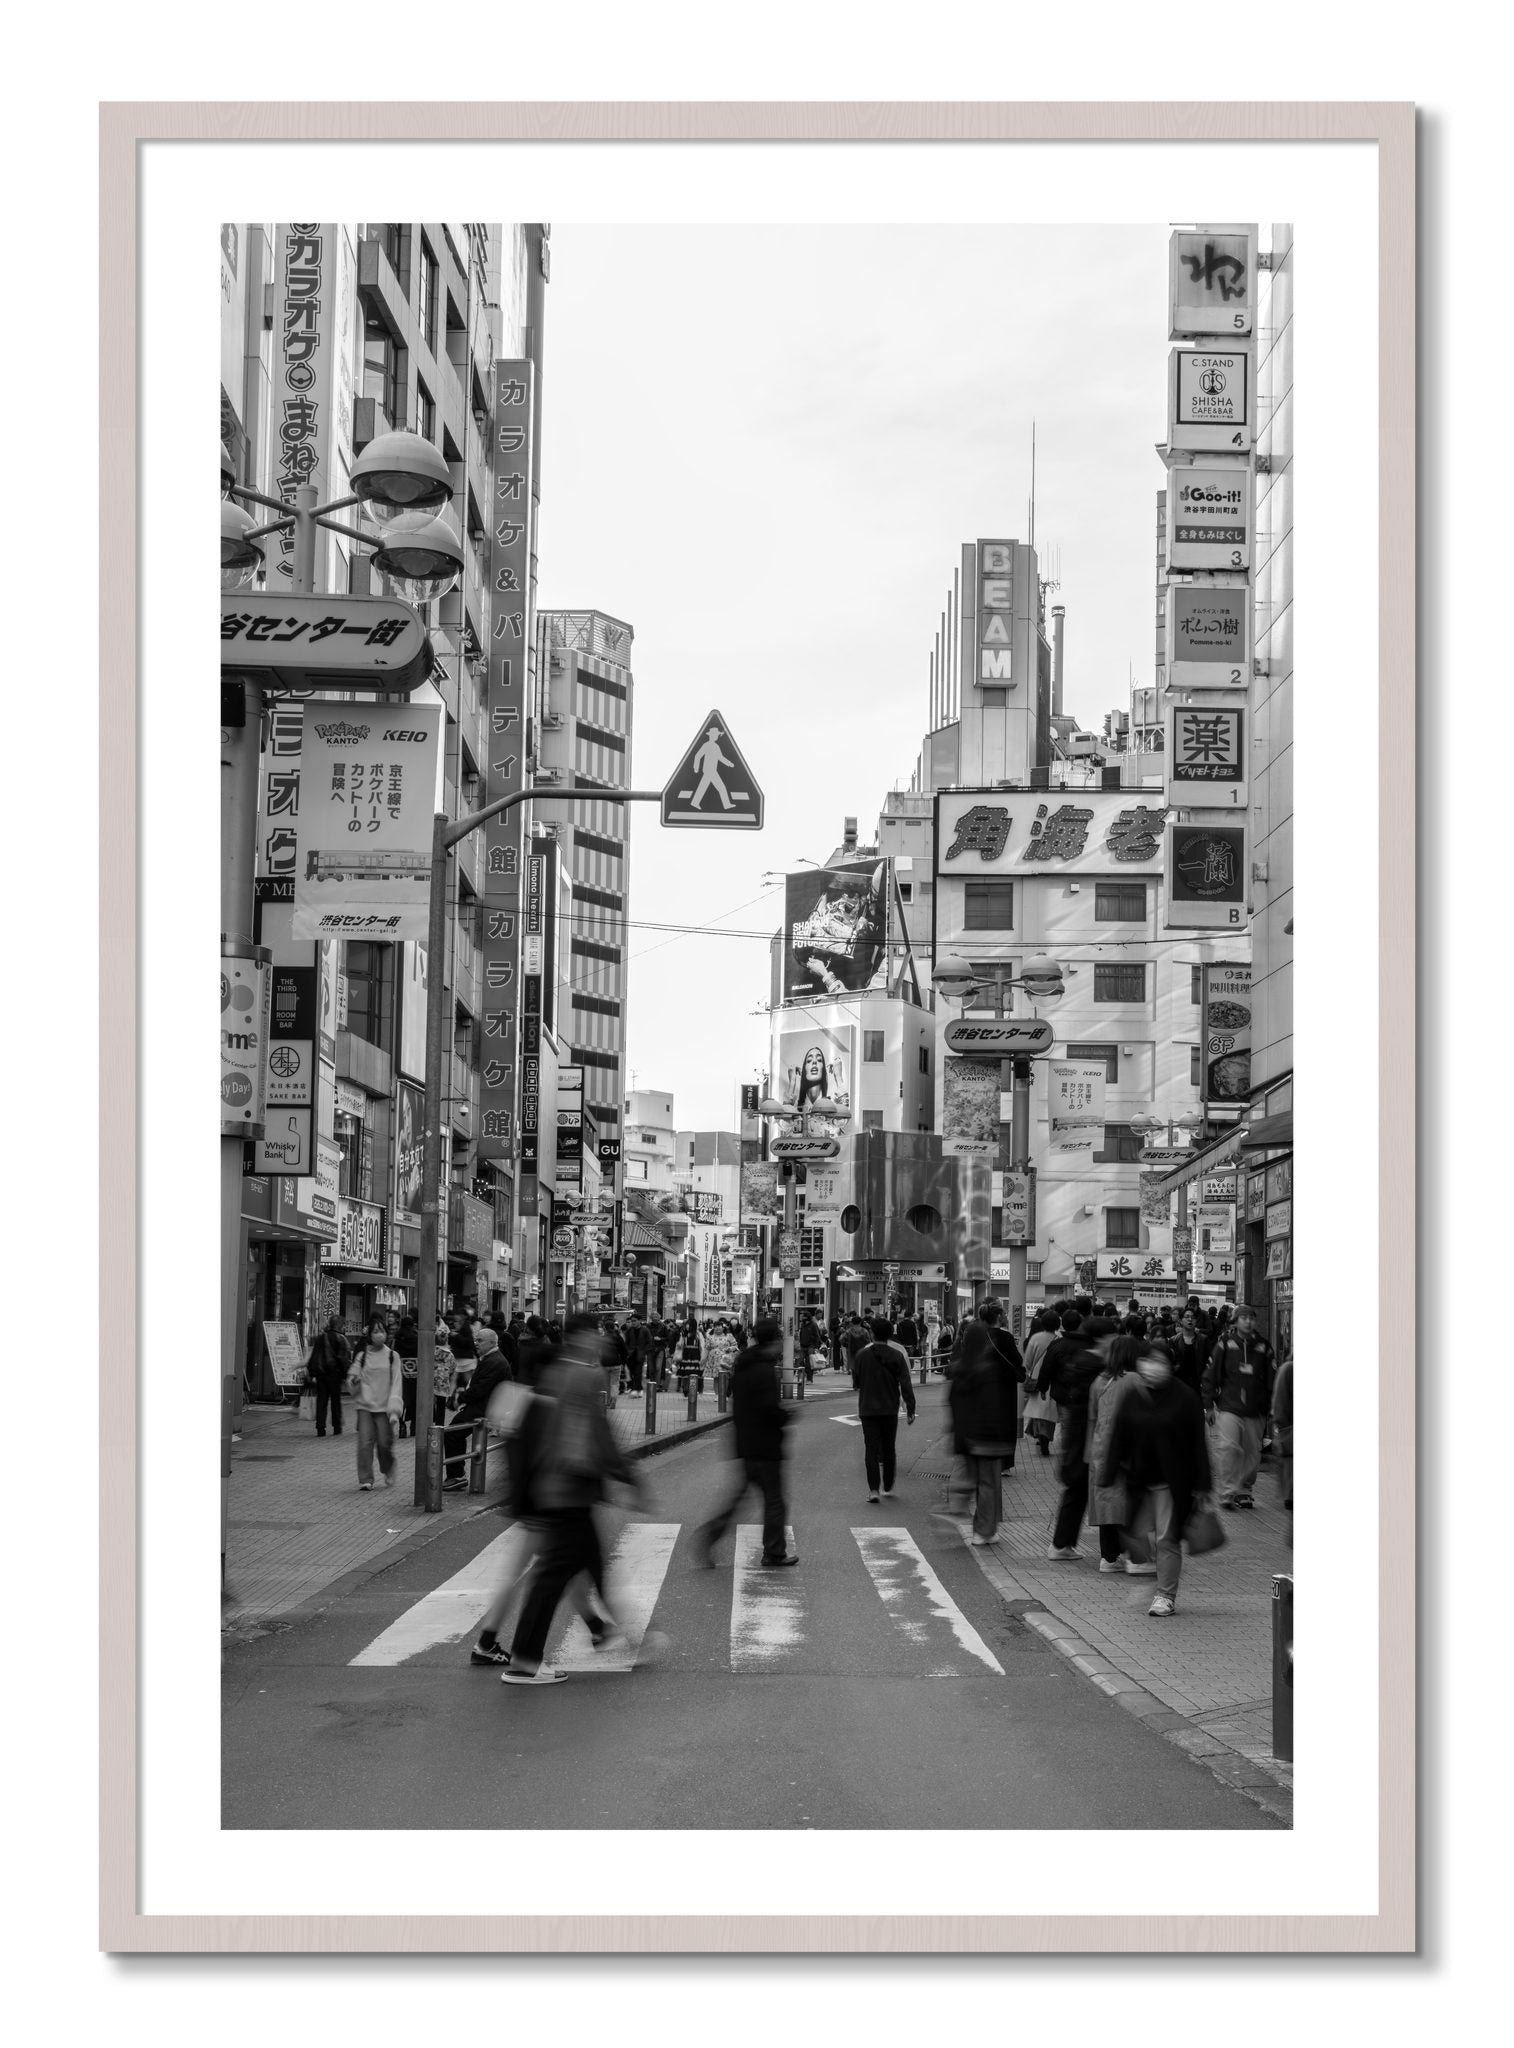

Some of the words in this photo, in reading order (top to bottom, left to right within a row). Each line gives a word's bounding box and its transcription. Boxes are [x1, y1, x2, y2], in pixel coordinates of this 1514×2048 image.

[1180, 244, 1246, 301] わん
[283, 235, 322, 364] カラオケ
[1233, 314, 1245, 328] 5
[1191, 358, 1234, 368] C.STAND
[1191, 396, 1234, 407] SHISHA
[1191, 406, 1233, 415] CAFE&BAR
[1232, 432, 1244, 447] 4
[1183, 505, 1239, 515] 渋谷宇田川町店
[1179, 529, 1243, 541] 全身もみほぐし
[1231, 550, 1243, 566] 3
[982, 544, 1012, 678] BEAM
[1189, 638, 1233, 646] Pomme-no-ki
[1230, 668, 1242, 684] 2
[326, 737, 359, 745] KANTO
[382, 729, 428, 743] KEIO
[1182, 714, 1231, 763] 薬
[1177, 764, 1236, 780] マツモトキヨシ
[330, 763, 346, 804] 冒険へ
[347, 763, 365, 833] カントーの
[387, 764, 403, 820] 京王線で
[1230, 789, 1238, 803] 1
[945, 803, 1169, 862] 角海老
[1178, 840, 1235, 887] 一蘭
[531, 860, 540, 893] kimono
[318, 914, 403, 928] 渋谷センター街
[1229, 908, 1240, 923] B
[276, 1011, 297, 1019] ROOM
[279, 1021, 293, 1029] BAR
[481, 912, 514, 1139] カラオケ館
[951, 1028, 1047, 1040] 渋谷センター街
[1208, 1035, 1235, 1055] 6F
[232, 1082, 251, 1095] Day!
[265, 1142, 297, 1152] Whisky
[600, 1144, 619, 1155] GU
[264, 1151, 284, 1159] Bank
[711, 1254, 720, 1294] BEER
